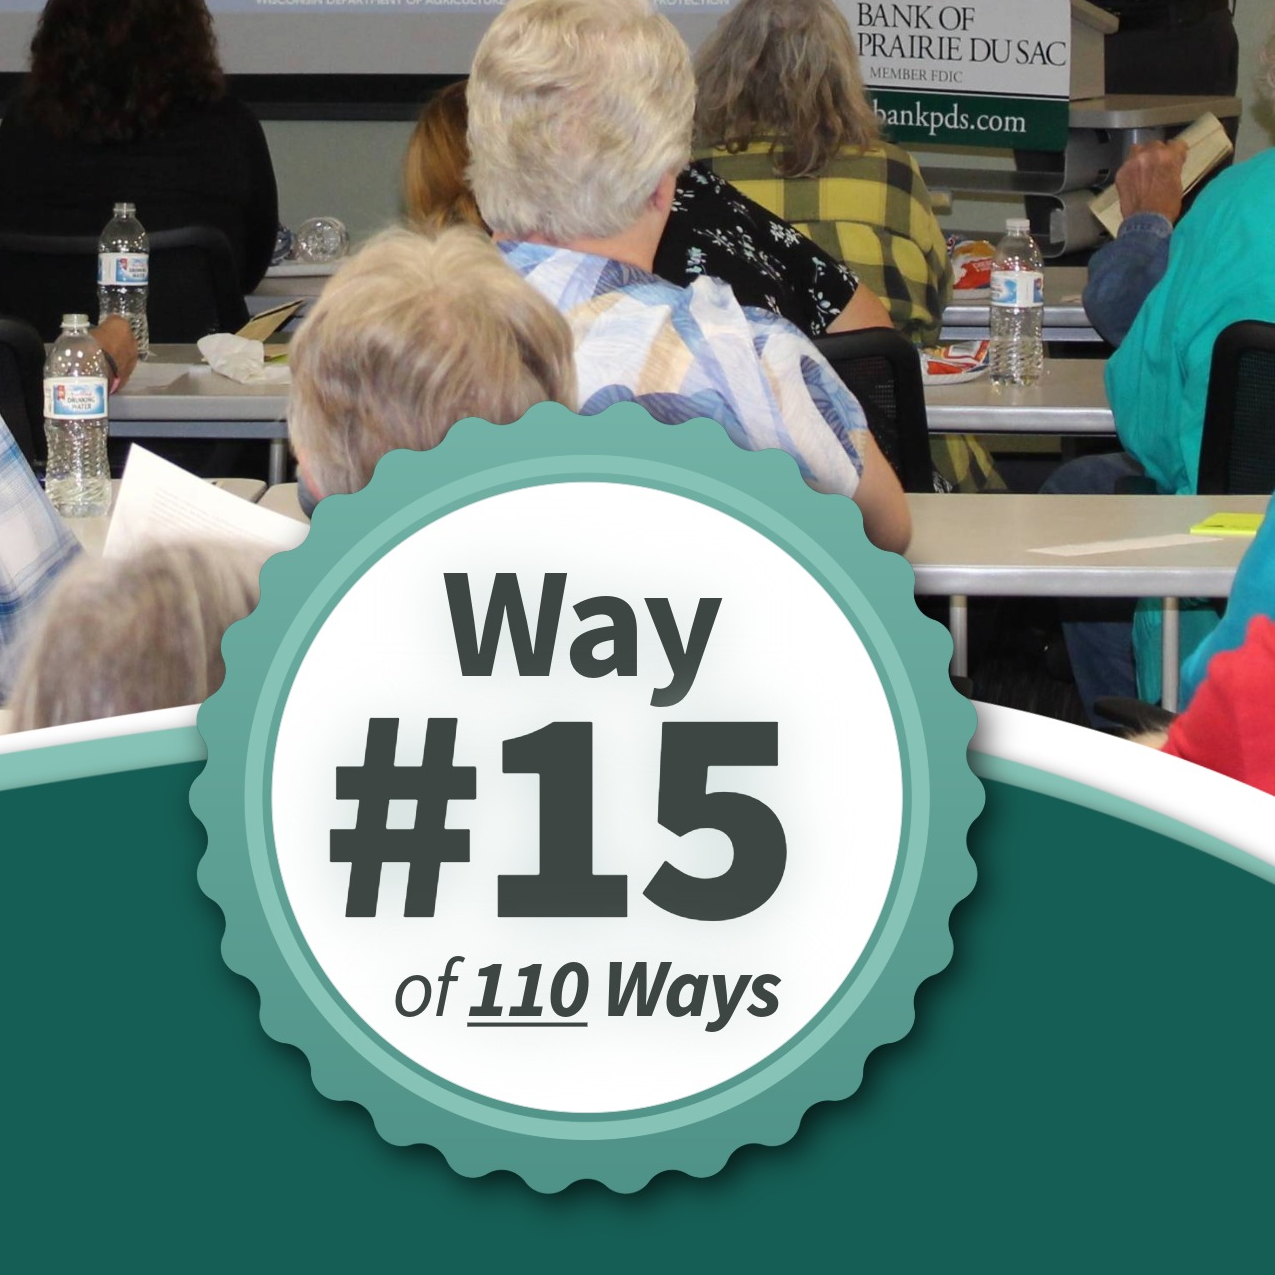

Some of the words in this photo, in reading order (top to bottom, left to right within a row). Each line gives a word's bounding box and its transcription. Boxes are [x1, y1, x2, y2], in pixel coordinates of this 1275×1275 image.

[857, 2, 933, 29] BANK
[939, 6, 975, 31] OF
[858, 32, 963, 61] PRAIRIE
[969, 38, 1012, 64] DU
[1016, 40, 1066, 66] SAC
[869, 66, 927, 81] MEMBER
[930, 70, 963, 83] FDIC
